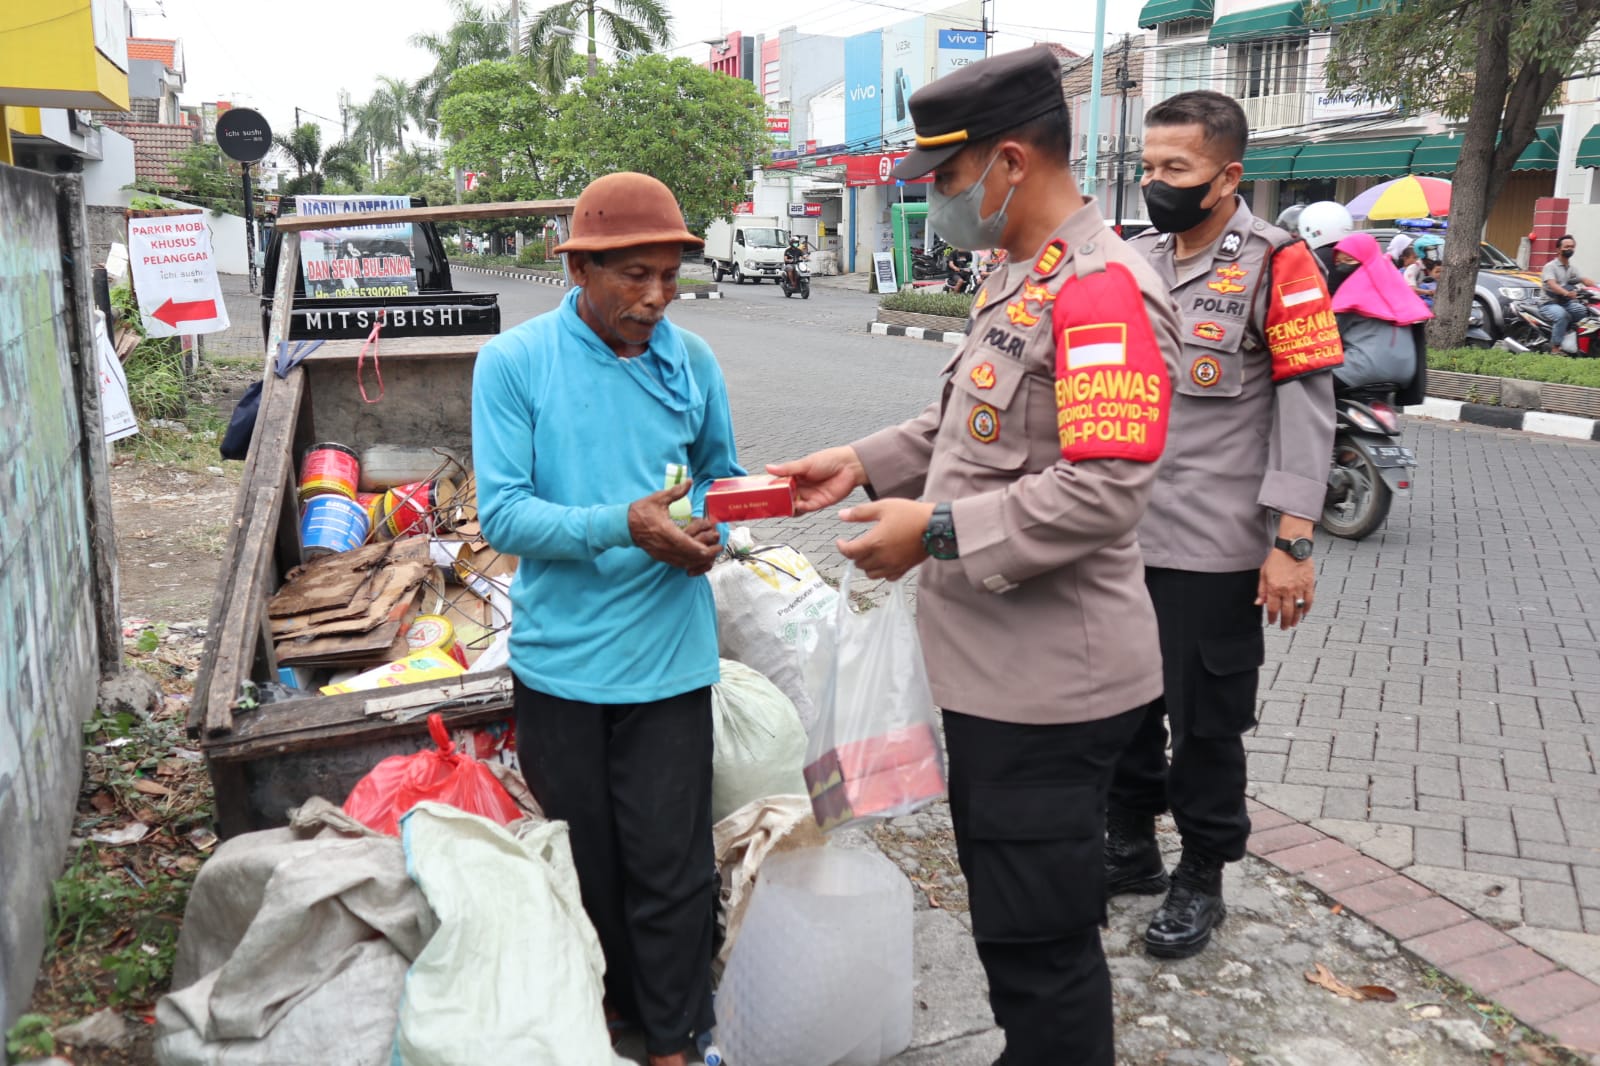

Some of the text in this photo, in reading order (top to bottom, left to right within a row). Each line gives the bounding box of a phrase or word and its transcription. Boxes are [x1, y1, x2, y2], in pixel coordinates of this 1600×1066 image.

[948, 34, 977, 44] vivo
[850, 84, 876, 100] vivo
[133, 224, 172, 235] PARKIR
[151, 238, 197, 249] KHUSUS
[143, 252, 208, 265] PELANGGAN
[181, 269, 203, 278] sushi
[308, 256, 411, 280] DAN SEWA BULANAN
[1192, 298, 1245, 316] POLRI
[306, 308, 463, 330] MITSUBISHI
[1266, 310, 1337, 343] PENGAWA
[983, 327, 1026, 358] POLRI
[1055, 370, 1160, 408] ENGAWAS
[1097, 402, 1160, 422] COVID-19
